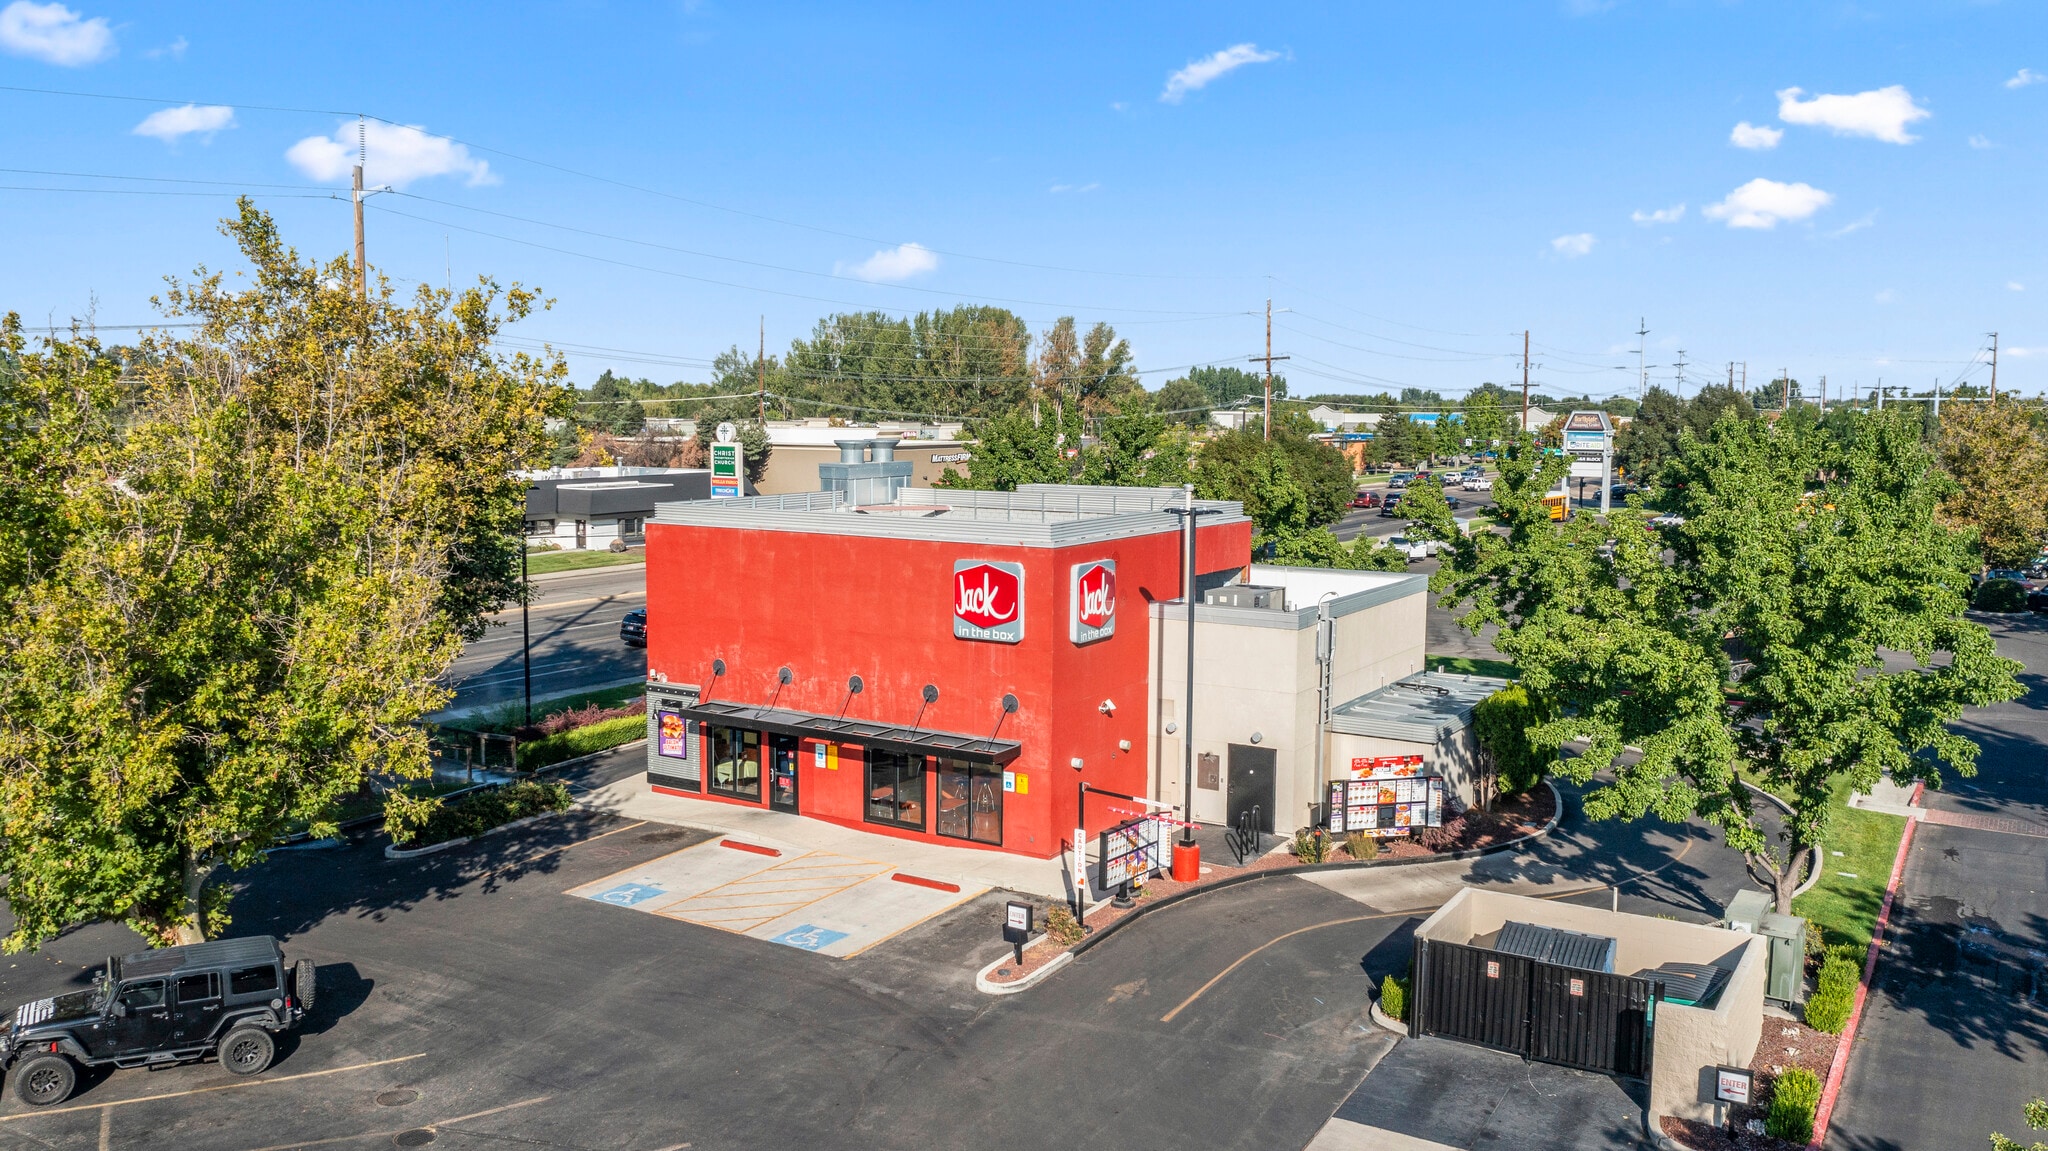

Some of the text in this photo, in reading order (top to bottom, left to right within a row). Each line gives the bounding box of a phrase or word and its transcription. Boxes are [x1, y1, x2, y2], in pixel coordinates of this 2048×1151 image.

[956, 572, 1015, 620] Jack
[1081, 572, 1115, 620] Jack
[958, 625, 1015, 641] in the box
[1080, 625, 1113, 641] in the box
[1720, 1077, 1747, 1090] ENTER
